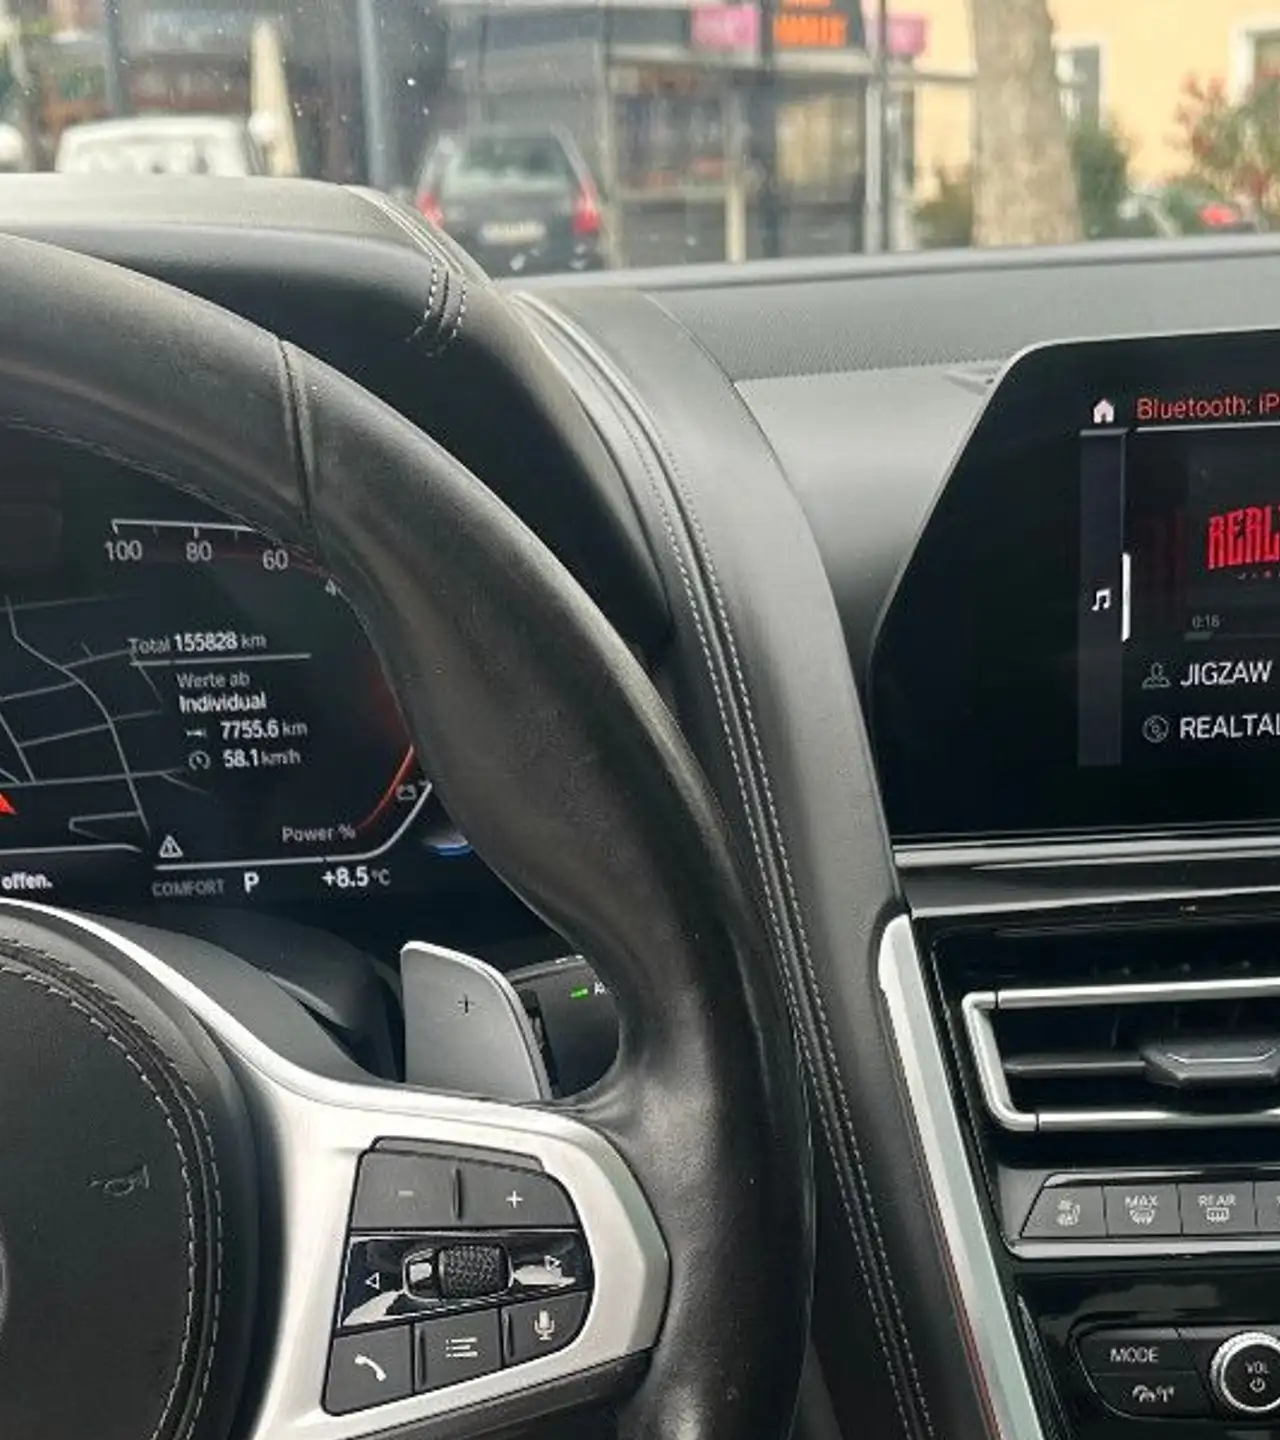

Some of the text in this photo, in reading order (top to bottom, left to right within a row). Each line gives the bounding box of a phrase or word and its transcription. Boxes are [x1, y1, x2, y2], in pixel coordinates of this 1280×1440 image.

[1136, 395, 1252, 419] Bluetooth:
[104, 539, 143, 562] 100
[185, 539, 213, 562] 80
[261, 549, 289, 571] 60
[127, 630, 268, 655] Total 155828 km
[176, 671, 251, 689] Werte ab
[1179, 660, 1273, 688] JIGZAW
[178, 691, 268, 714] Individual
[220, 719, 308, 741] 7755.6 km
[222, 748, 260, 769] 58.1
[281, 824, 356, 843] Power %
[151, 878, 225, 898] COMFORT
[243, 871, 260, 893] P
[322, 866, 370, 888] +8.5
[1109, 1346, 1160, 1364] MODE
